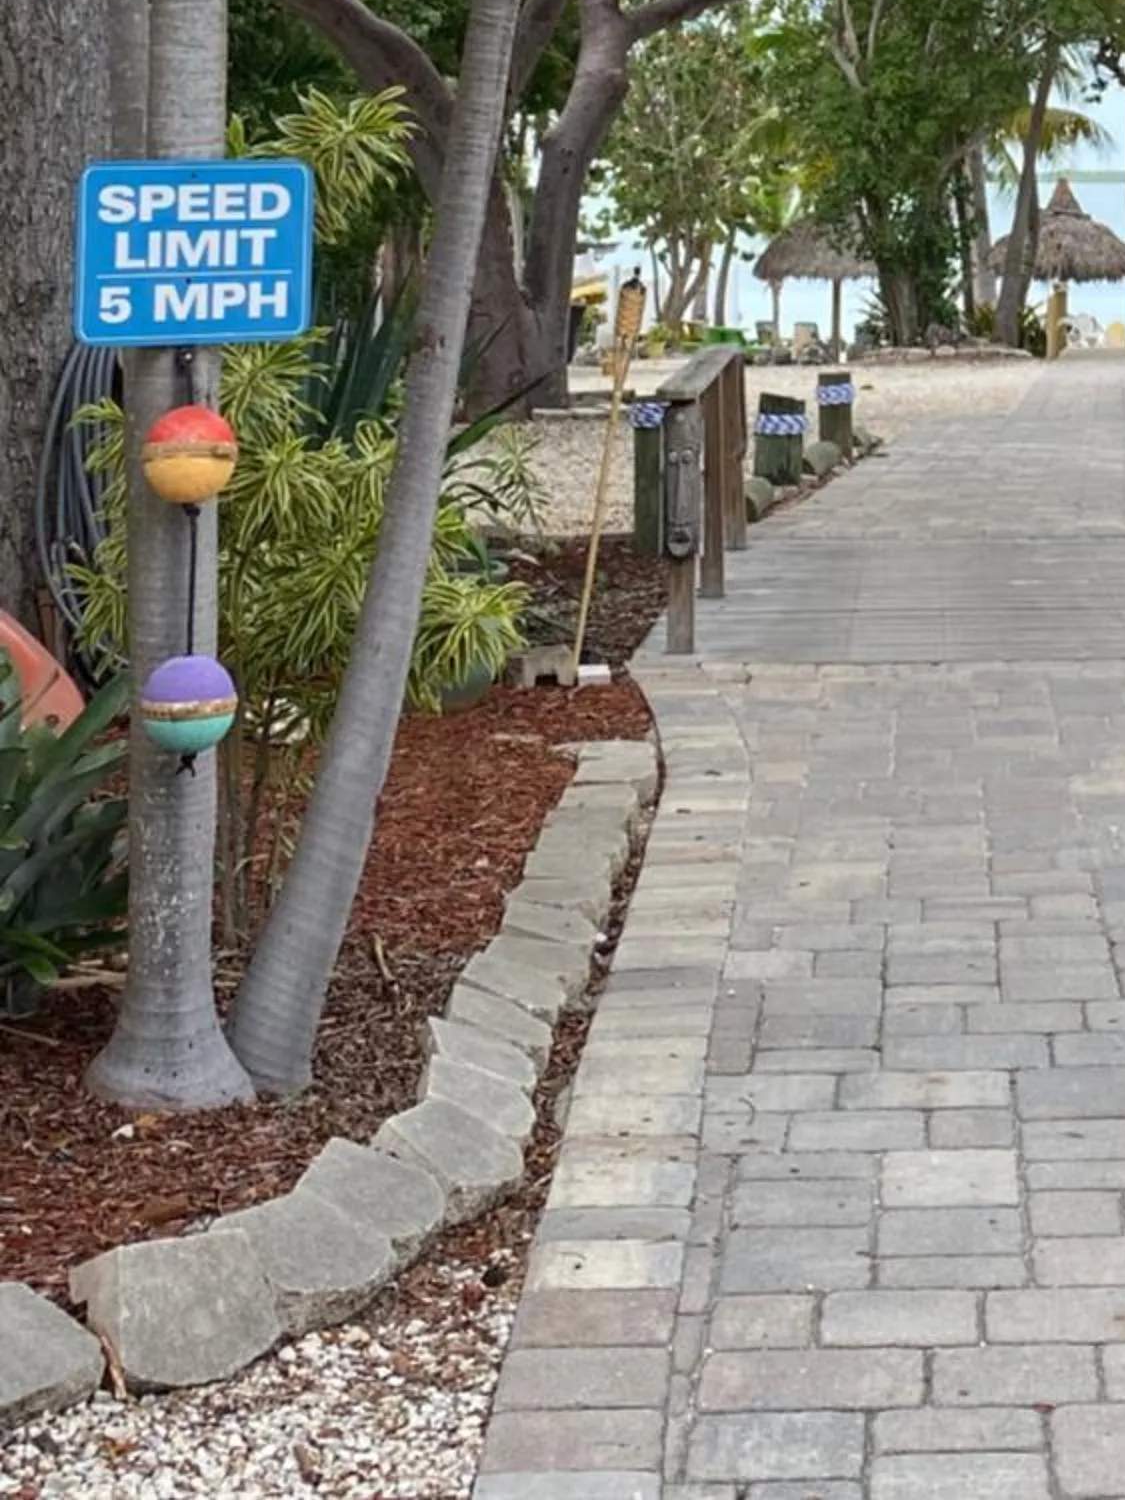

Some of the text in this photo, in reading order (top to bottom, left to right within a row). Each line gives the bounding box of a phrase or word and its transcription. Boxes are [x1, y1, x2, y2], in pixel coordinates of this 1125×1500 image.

[98, 183, 291, 223] SPEED
[115, 229, 277, 269] LIMIT
[98, 281, 288, 323] 5 MPH
